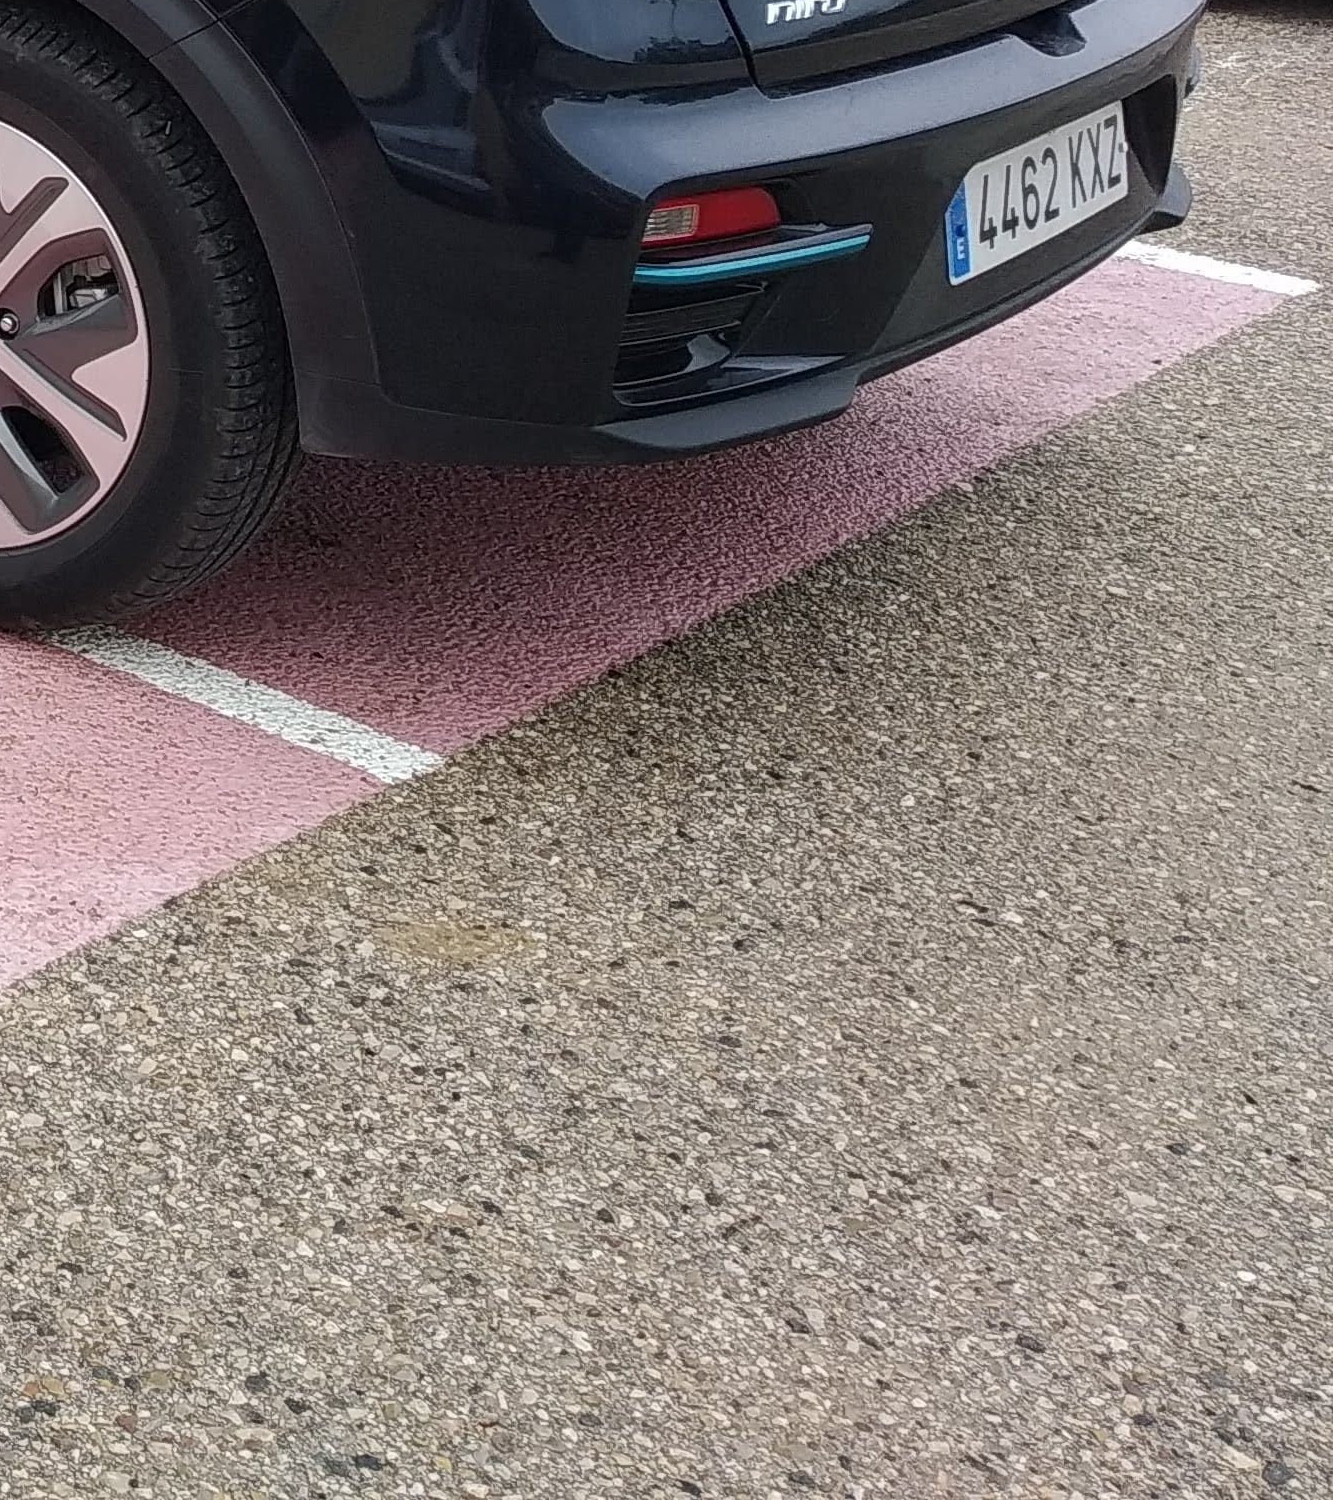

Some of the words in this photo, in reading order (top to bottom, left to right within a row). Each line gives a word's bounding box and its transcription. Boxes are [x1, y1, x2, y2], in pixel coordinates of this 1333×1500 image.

[956, 238, 966, 260] E
[979, 147, 1060, 249] 4462
[1068, 114, 1122, 209] KXZ
